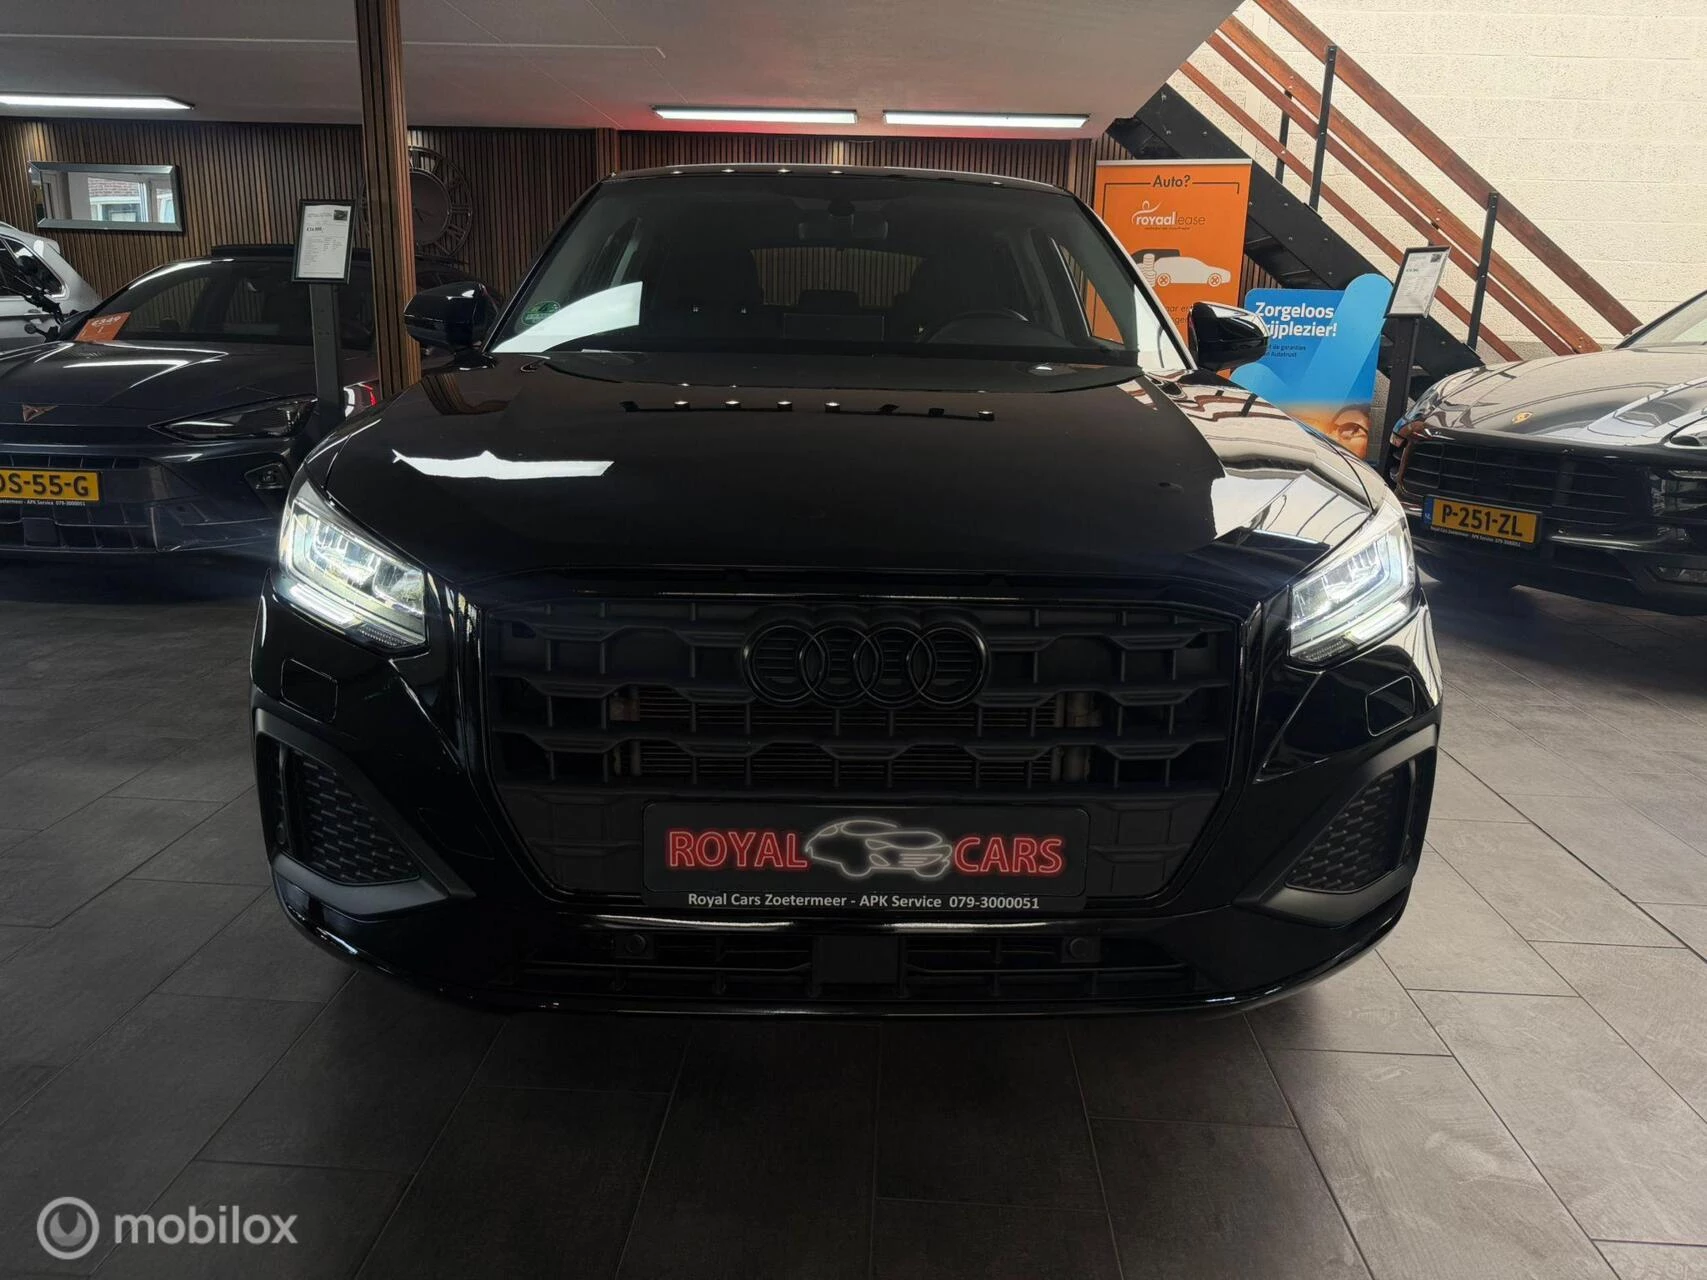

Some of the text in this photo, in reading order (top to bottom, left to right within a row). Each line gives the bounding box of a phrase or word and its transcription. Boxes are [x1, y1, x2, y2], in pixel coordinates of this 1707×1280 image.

[1152, 174, 1191, 188] Auto?
[1255, 301, 1334, 321] Zorgeloos
[1441, 503, 1523, 537] P-251-ZL
[669, 831, 1063, 873] ROYAL CARS
[688, 892, 727, 908] Royal
[731, 893, 761, 906] Cars
[765, 893, 847, 906] Zoetermeer
[859, 895, 889, 907] APK
[891, 895, 942, 908] Service
[949, 896, 1040, 909] 079-3000051
